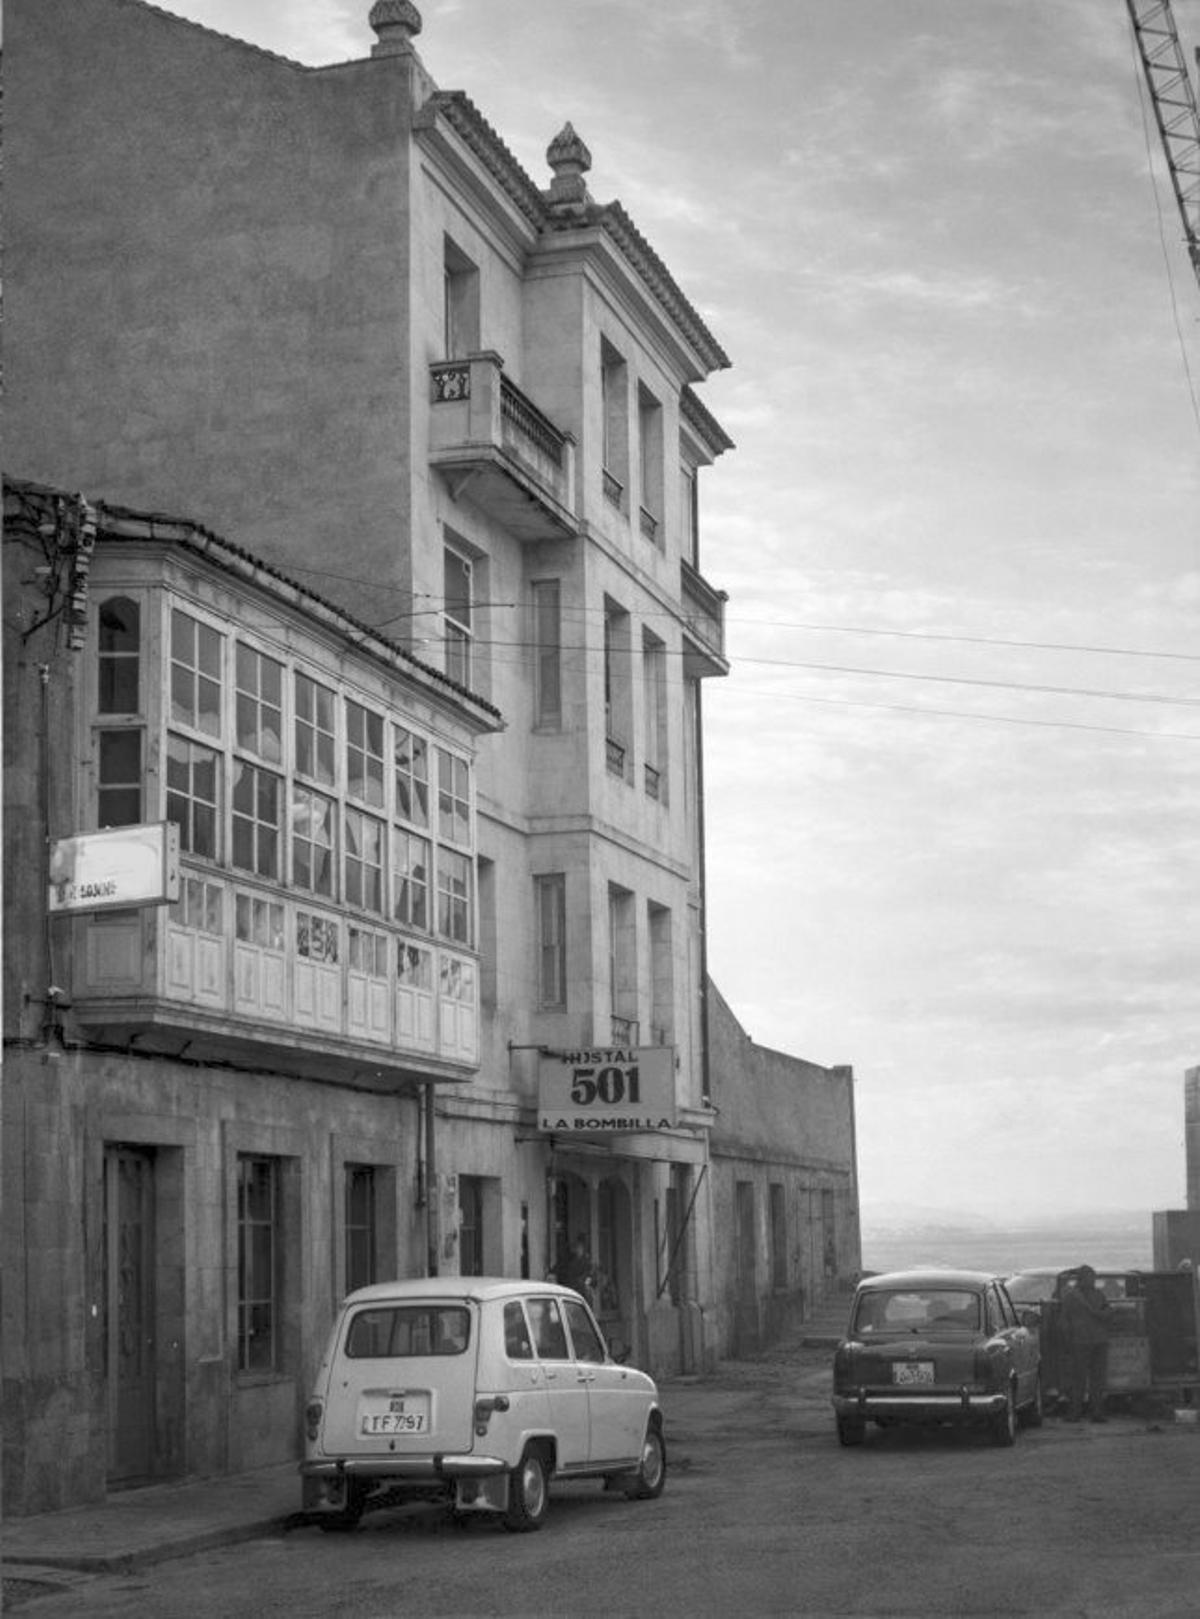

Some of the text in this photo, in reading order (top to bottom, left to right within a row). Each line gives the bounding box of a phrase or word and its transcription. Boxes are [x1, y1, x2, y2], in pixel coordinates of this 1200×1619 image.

[571, 1066, 641, 1105] 501
[542, 1118, 672, 1129] LA BOMBILLA
